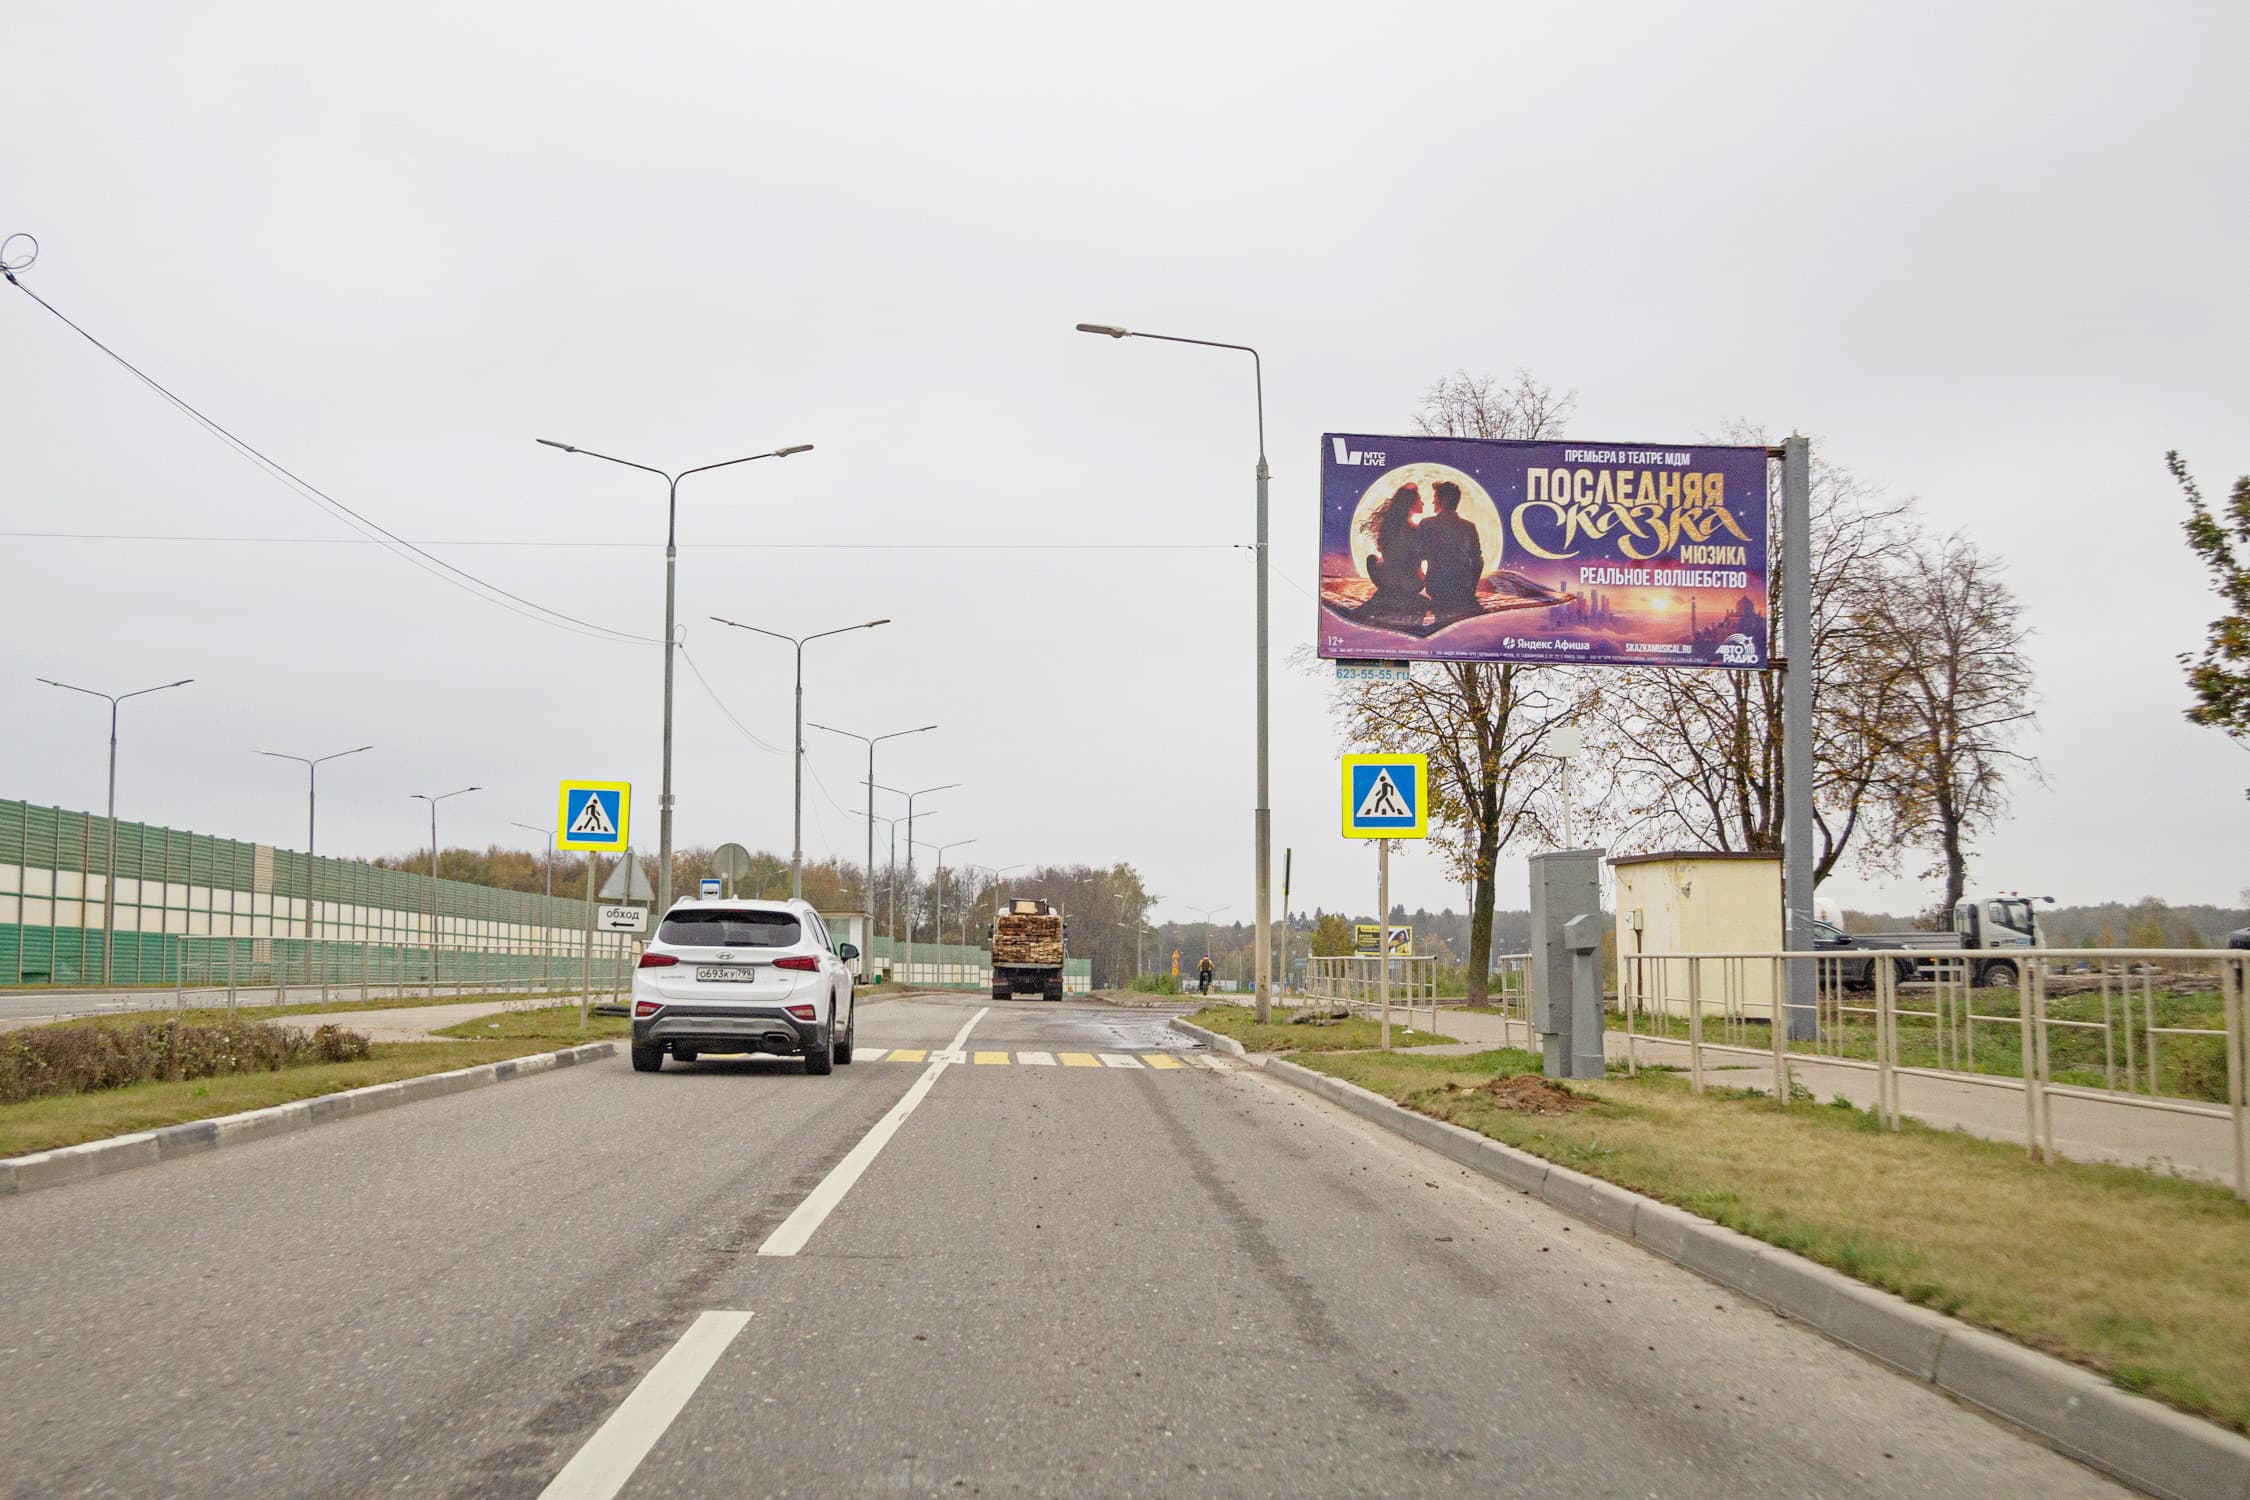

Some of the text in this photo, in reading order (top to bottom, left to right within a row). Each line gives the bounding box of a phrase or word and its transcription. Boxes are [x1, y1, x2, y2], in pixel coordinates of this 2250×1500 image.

[1363, 459, 1386, 467] LIVE
[1565, 449, 1691, 466] ПРЕМЬЕРА В ТЕАТРЕ МДМ
[1526, 467, 1725, 510] ПОСЛЕДНЯЯ
[1680, 544, 1747, 566] МЮЗИКЛ
[1579, 567, 1748, 589] РЕАЛЬНОЕ ВОЛШЕБСТВО
[1327, 635, 1345, 647] 12+
[1517, 638, 1591, 652] Яндекс Афиша
[1625, 642, 1693, 654] SKAZKAMUSICAL.RU
[1714, 644, 1744, 656] АВТО
[1722, 653, 1759, 664] РАДИО
[1336, 668, 1410, 681] 623-55-55.ru
[606, 908, 640, 920] обход
